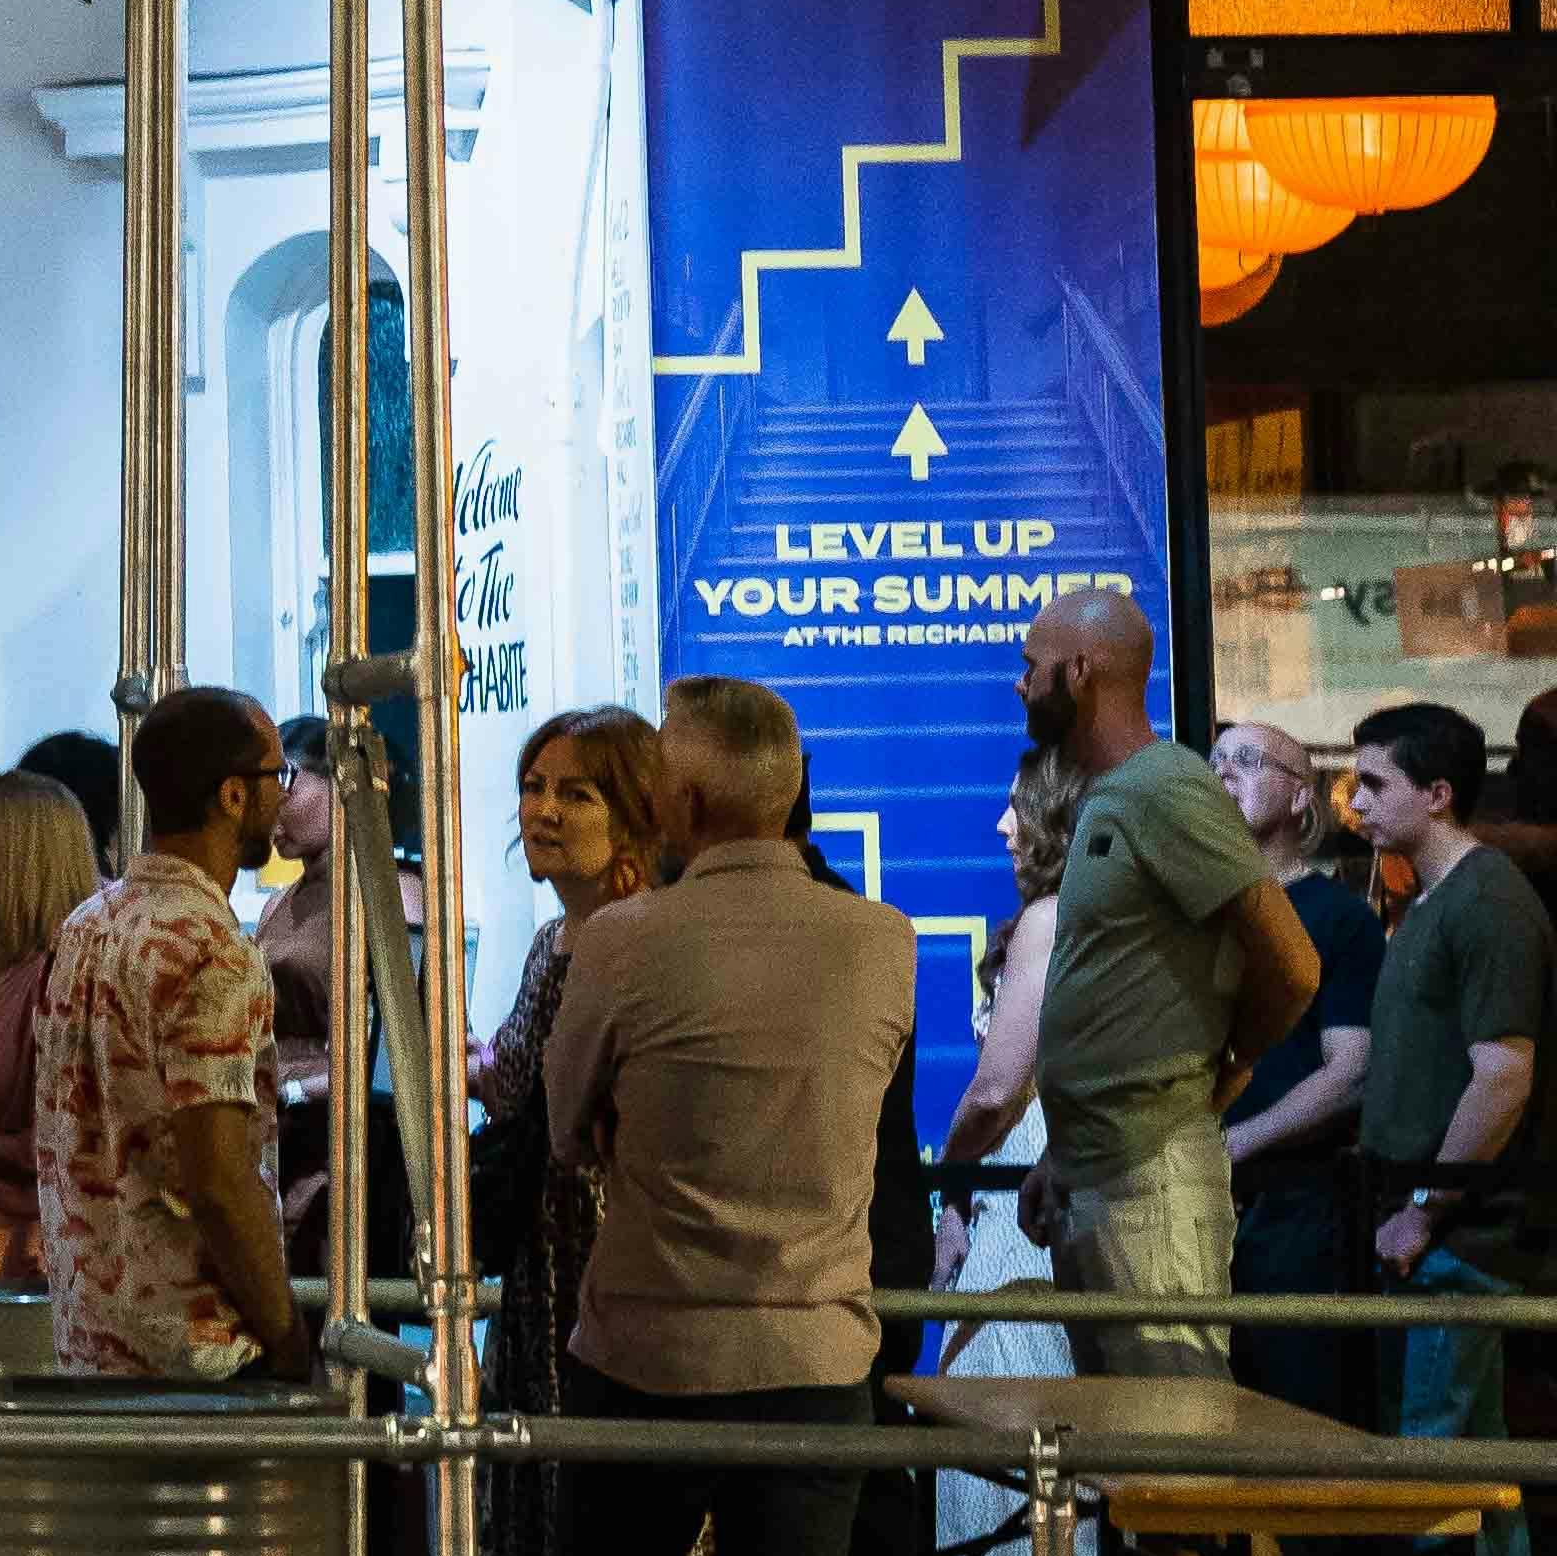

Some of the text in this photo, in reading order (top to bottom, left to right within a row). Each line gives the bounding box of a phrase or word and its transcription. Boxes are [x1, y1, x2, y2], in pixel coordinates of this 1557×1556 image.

[774, 518, 1056, 562] LEVEL UP
[479, 540, 514, 630] The
[693, 576, 861, 617] YOUR
[782, 622, 1033, 647] AT THE RECHABIT
[458, 640, 528, 713] HABITE
